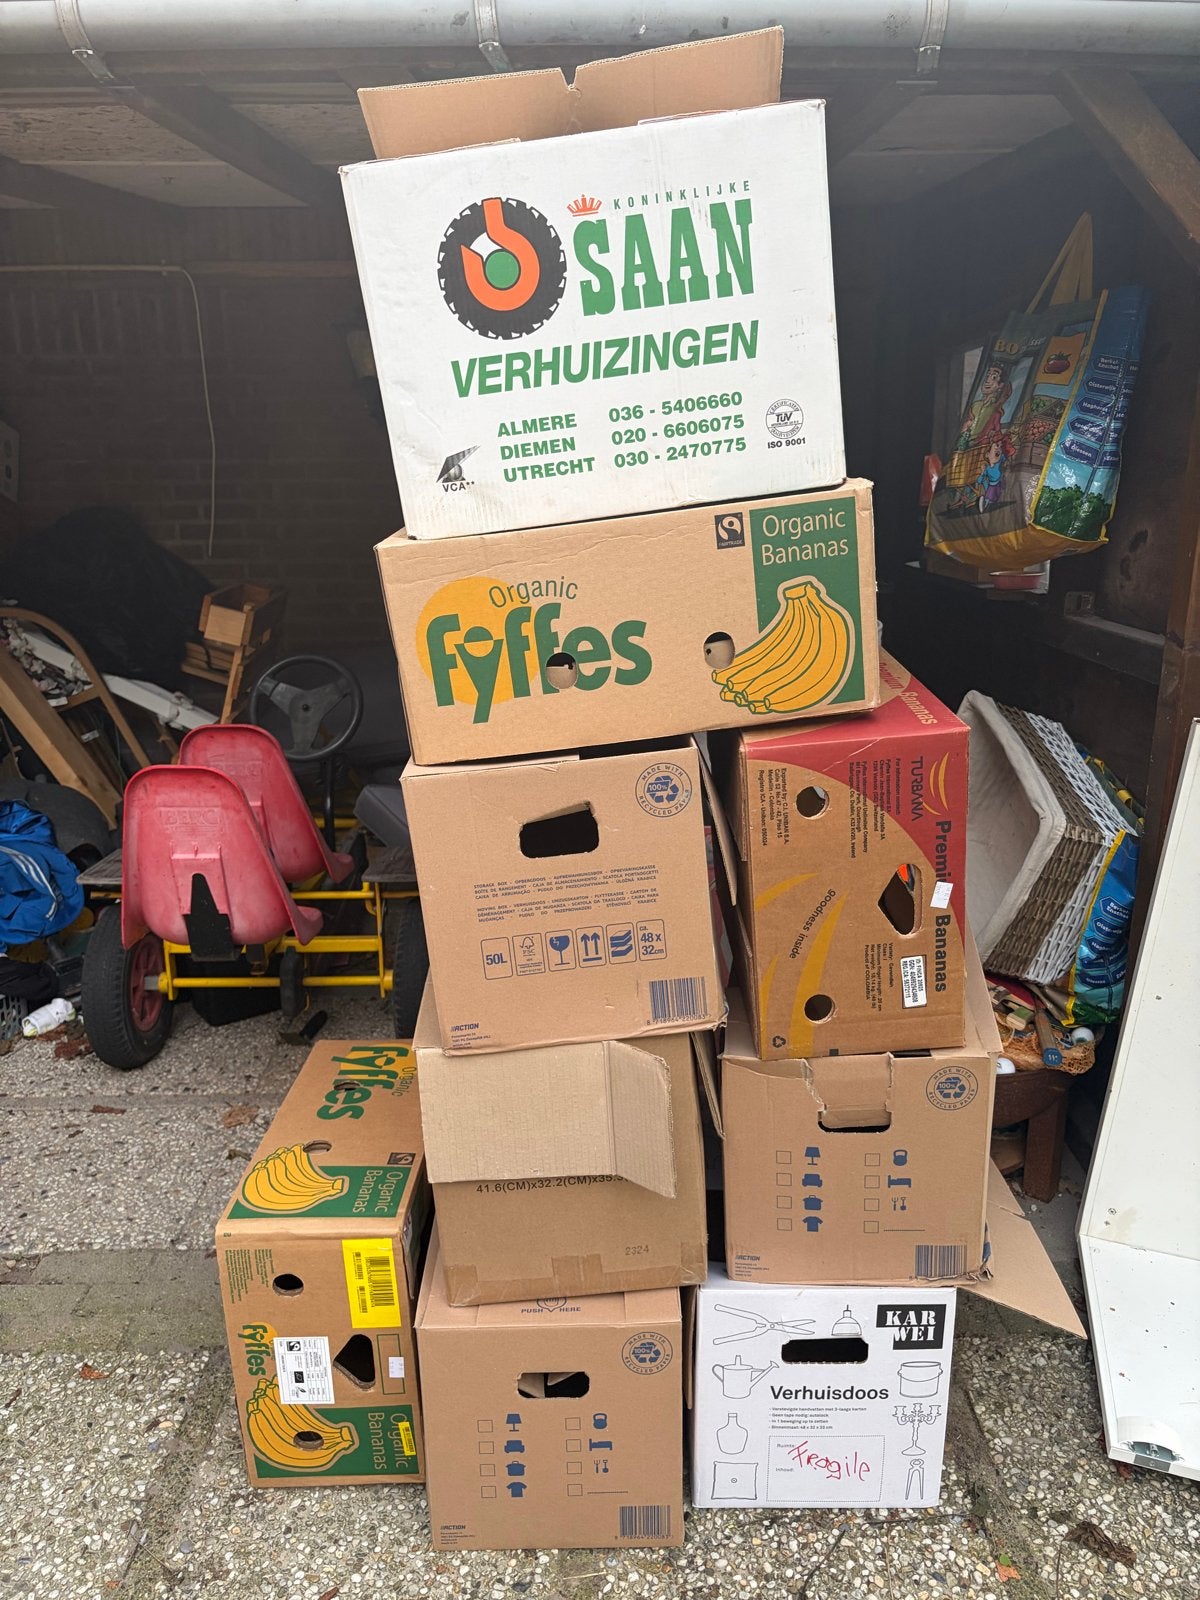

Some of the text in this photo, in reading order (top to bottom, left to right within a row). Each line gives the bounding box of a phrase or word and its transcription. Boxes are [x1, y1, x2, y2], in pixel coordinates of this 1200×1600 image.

[613, 180, 750, 210] KONINKLIJKE
[573, 198, 755, 317] SAAN
[450, 319, 760, 398] VERHUIZINGEN
[608, 391, 743, 423] 036 5406660
[497, 413, 578, 437] ALMERE
[611, 427, 647, 445] 020
[663, 414, 745, 439] 6606075
[500, 437, 576, 460] DIEMEN
[614, 436, 747, 468] 030 2470775
[767, 437, 806, 449] ISO 9001
[503, 457, 596, 482] UTRECHT
[762, 507, 846, 540] Organic
[761, 538, 849, 566] Bananas
[488, 575, 579, 609] Organic
[426, 602, 653, 725] fyffes
[899, 691, 938, 725] Bananas
[641, 765, 684, 781] MADE WITH
[648, 783, 668, 791] 100%
[911, 756, 924, 822] TURBANA
[639, 795, 673, 816] RECYCLED
[935, 820, 953, 882] Premi
[641, 932, 662, 943] 48 x
[789, 889, 837, 960] goodness inside
[485, 952, 508, 966] 50L
[935, 914, 951, 993] Bananas
[451, 1022, 480, 1032] ACTION
[316, 1046, 410, 1120] fyffes
[391, 1066, 417, 1097] Organic
[933, 1068, 972, 1080] MADE WITH
[352, 1169, 383, 1213] Bananas
[374, 1171, 404, 1213] Organic
[625, 1245, 650, 1256] 2324
[884, 1310, 937, 1327] KAR
[893, 1326, 935, 1342] WEI
[237, 1324, 271, 1376] fyffes
[628, 1333, 666, 1345] MADE WITH
[770, 1385, 889, 1401] Verhuisdoos
[367, 1412, 387, 1470] Bananas
[787, 1440, 870, 1481] Fragile
